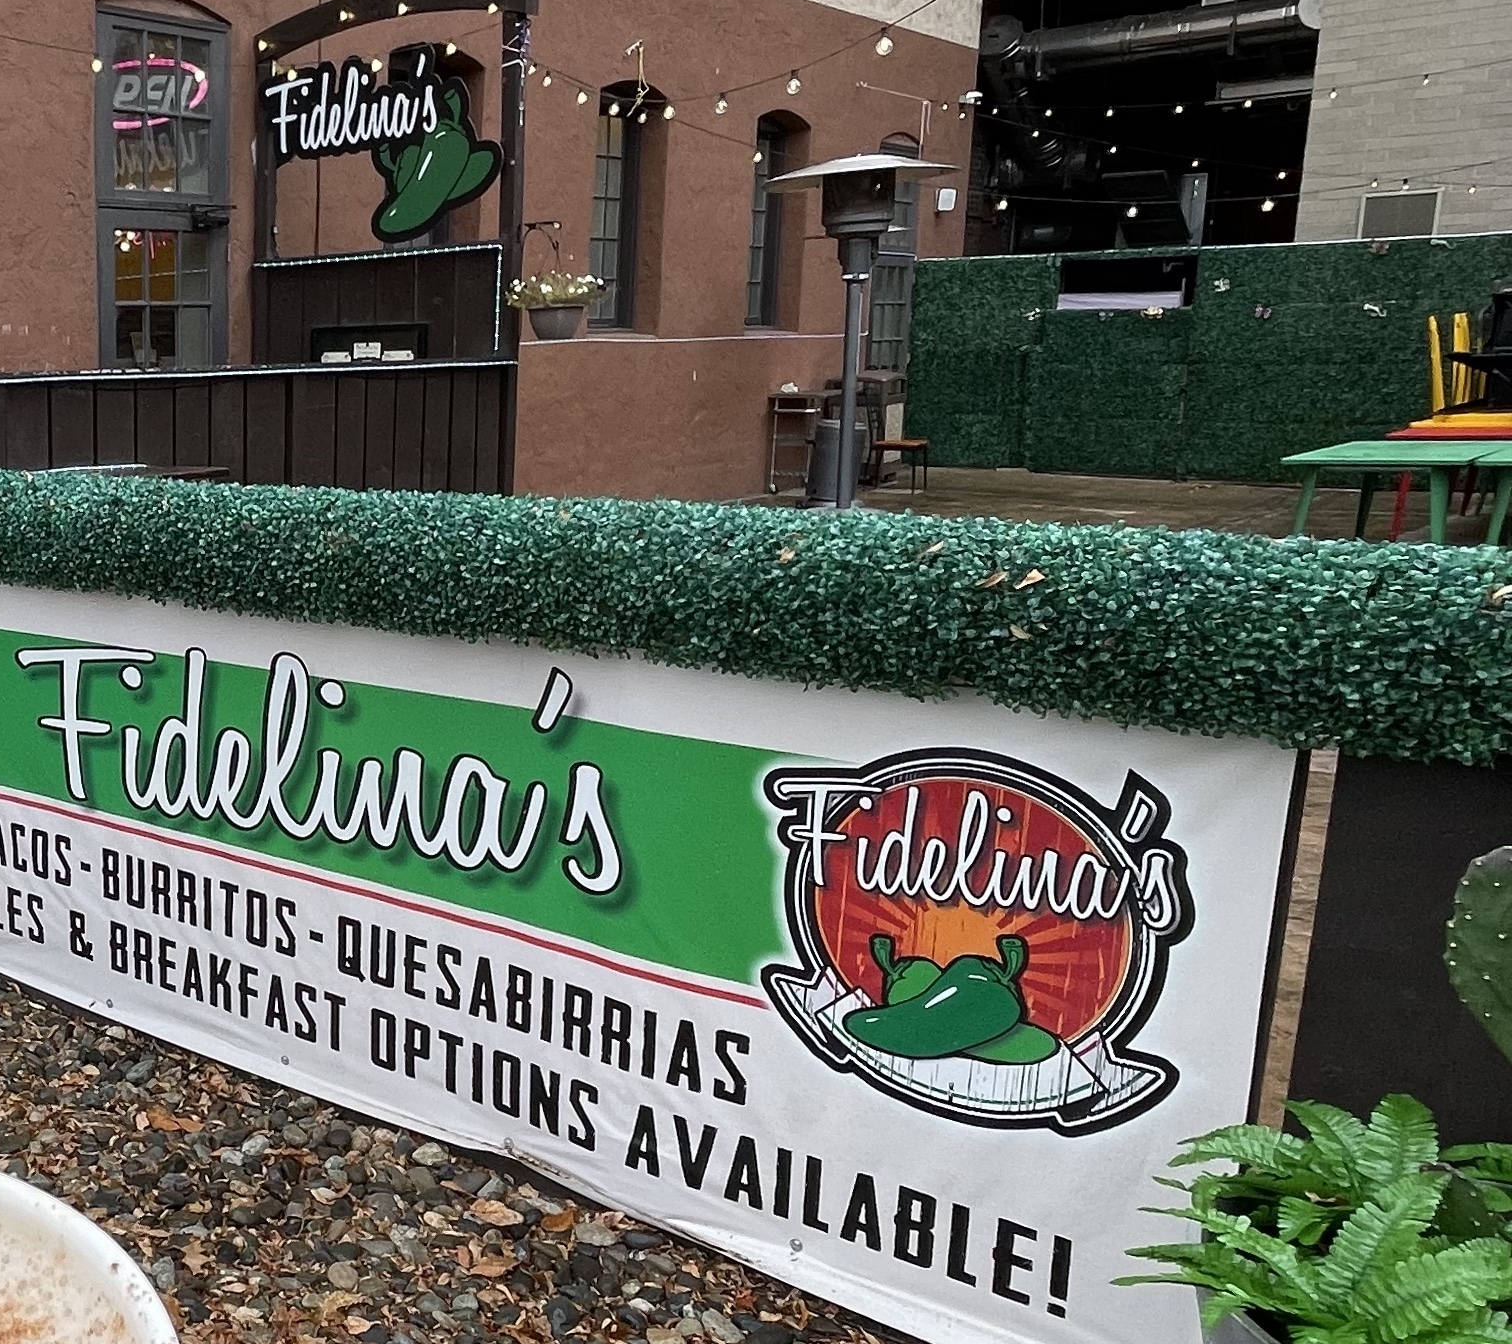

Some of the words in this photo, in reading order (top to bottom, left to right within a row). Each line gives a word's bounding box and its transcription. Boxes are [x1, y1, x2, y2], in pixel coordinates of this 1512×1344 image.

[265, 53, 438, 154] Fidelina's
[14, 646, 623, 895] Fidelina's
[775, 776, 1182, 935] Fidelina's
[69, 909, 94, 961] &
[109, 920, 347, 1052] BREAKFAST
[370, 1007, 599, 1152] OPTIONS
[624, 1104, 1073, 1320] AVAILABLE!
